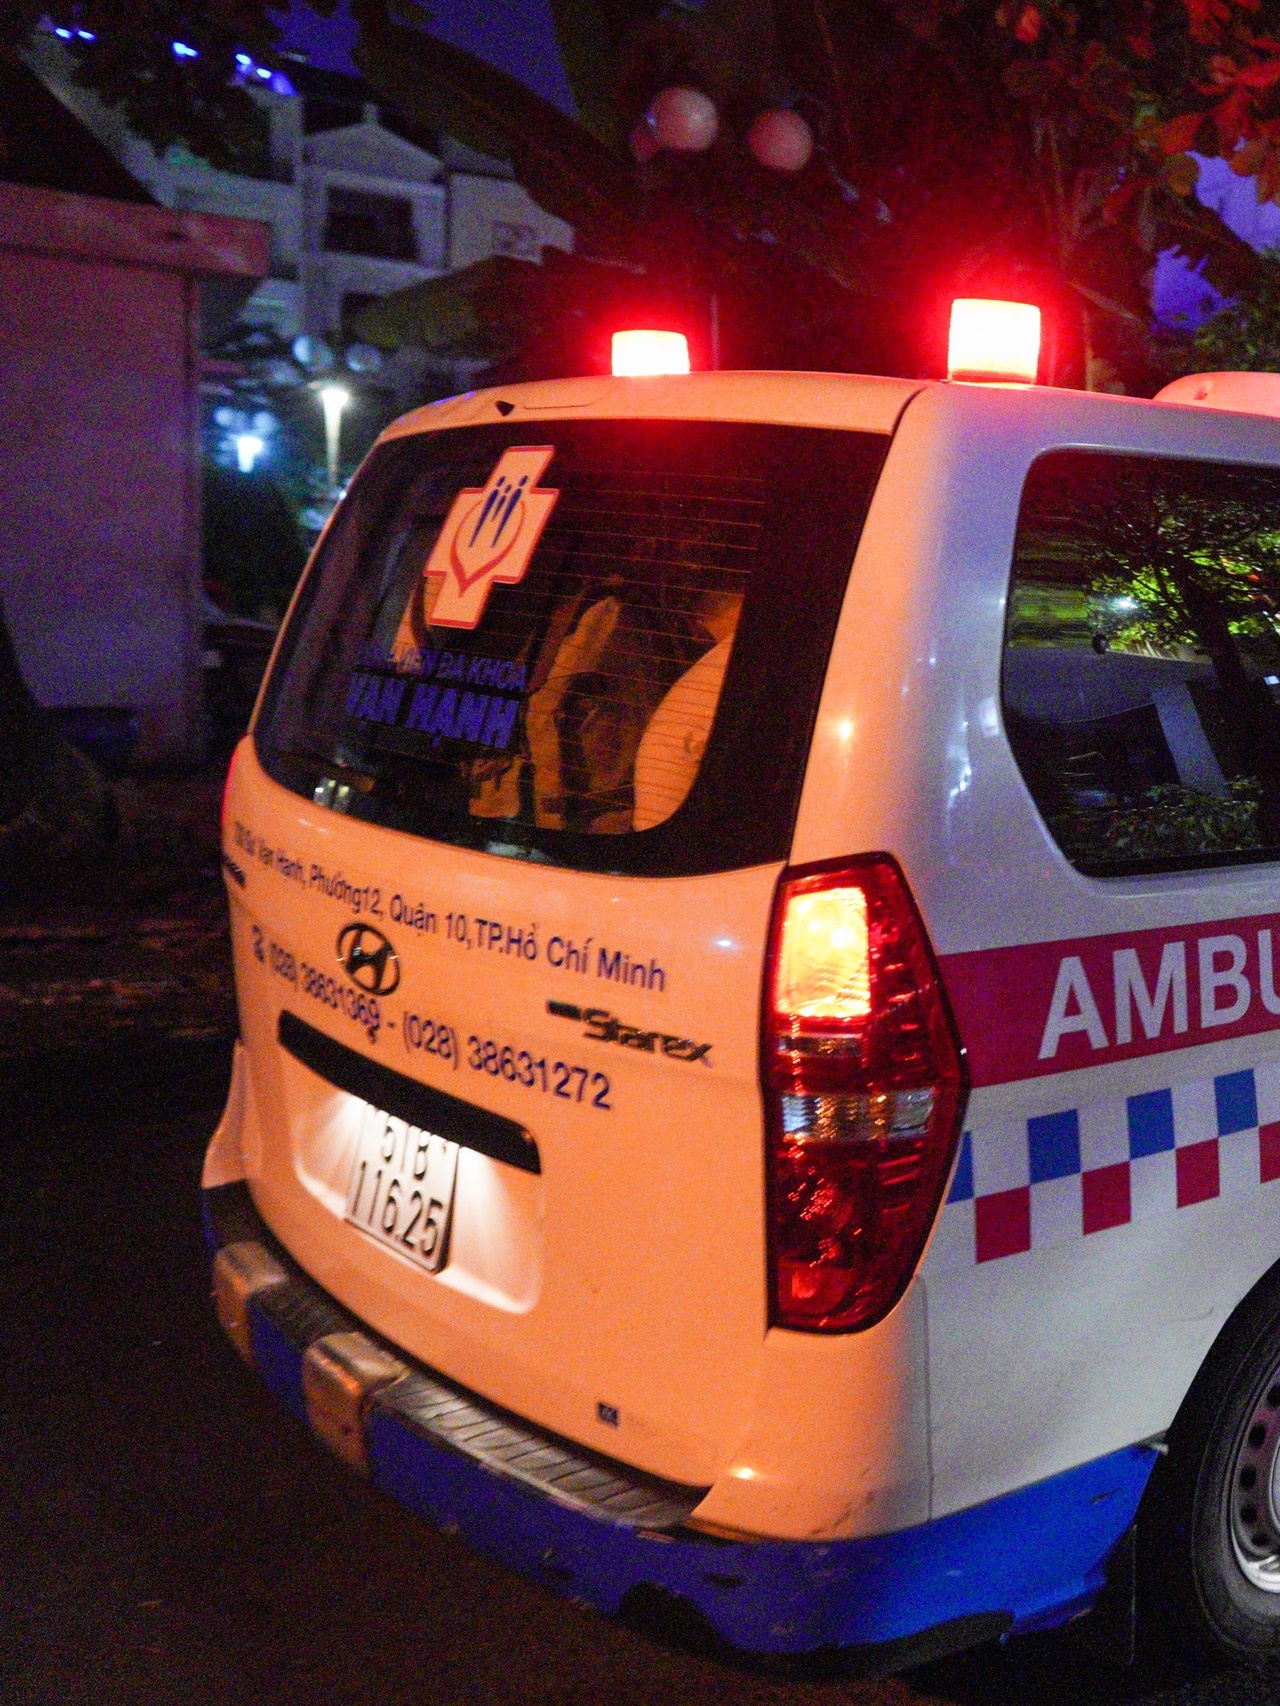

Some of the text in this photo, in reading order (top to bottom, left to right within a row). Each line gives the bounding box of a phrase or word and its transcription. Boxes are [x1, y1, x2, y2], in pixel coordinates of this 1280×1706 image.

[406, 683, 519, 749] HẠNH
[390, 894, 436, 938] Quận
[546, 936, 592, 975] Chí
[597, 947, 666, 992] Minh
[403, 1010, 460, 1070] (028)
[467, 1035, 612, 1111] 38631272
[583, 1007, 712, 1068] Starex
[352, 1158, 443, 1259] 116.25
